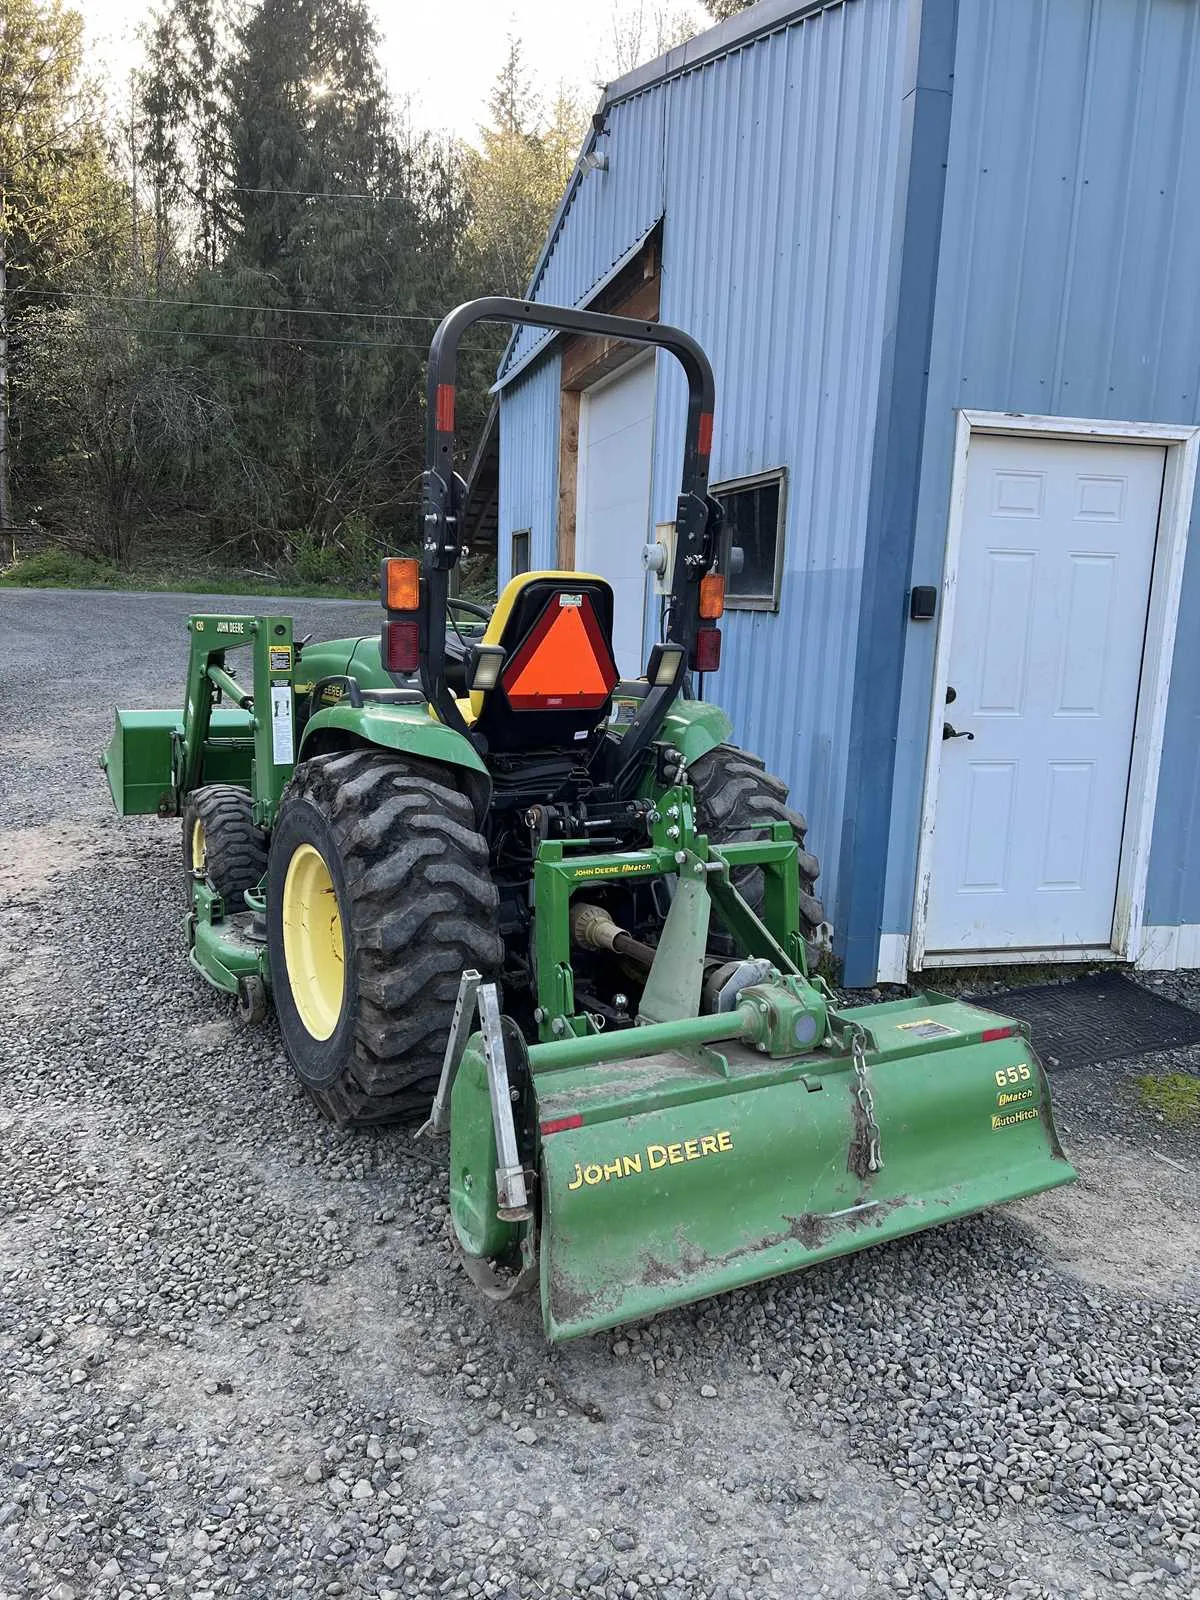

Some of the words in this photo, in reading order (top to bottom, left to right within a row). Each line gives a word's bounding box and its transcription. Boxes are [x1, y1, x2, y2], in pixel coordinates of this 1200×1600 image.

[216, 622, 229, 633] JOHN
[229, 622, 244, 634] DEERE
[574, 868, 594, 877] JOHN
[594, 866, 619, 875] DEERE
[995, 1063, 1031, 1087] 655
[993, 1107, 1039, 1130] AutoHitch
[568, 1153, 643, 1191] JOHN
[647, 1130, 734, 1171] DEERE
